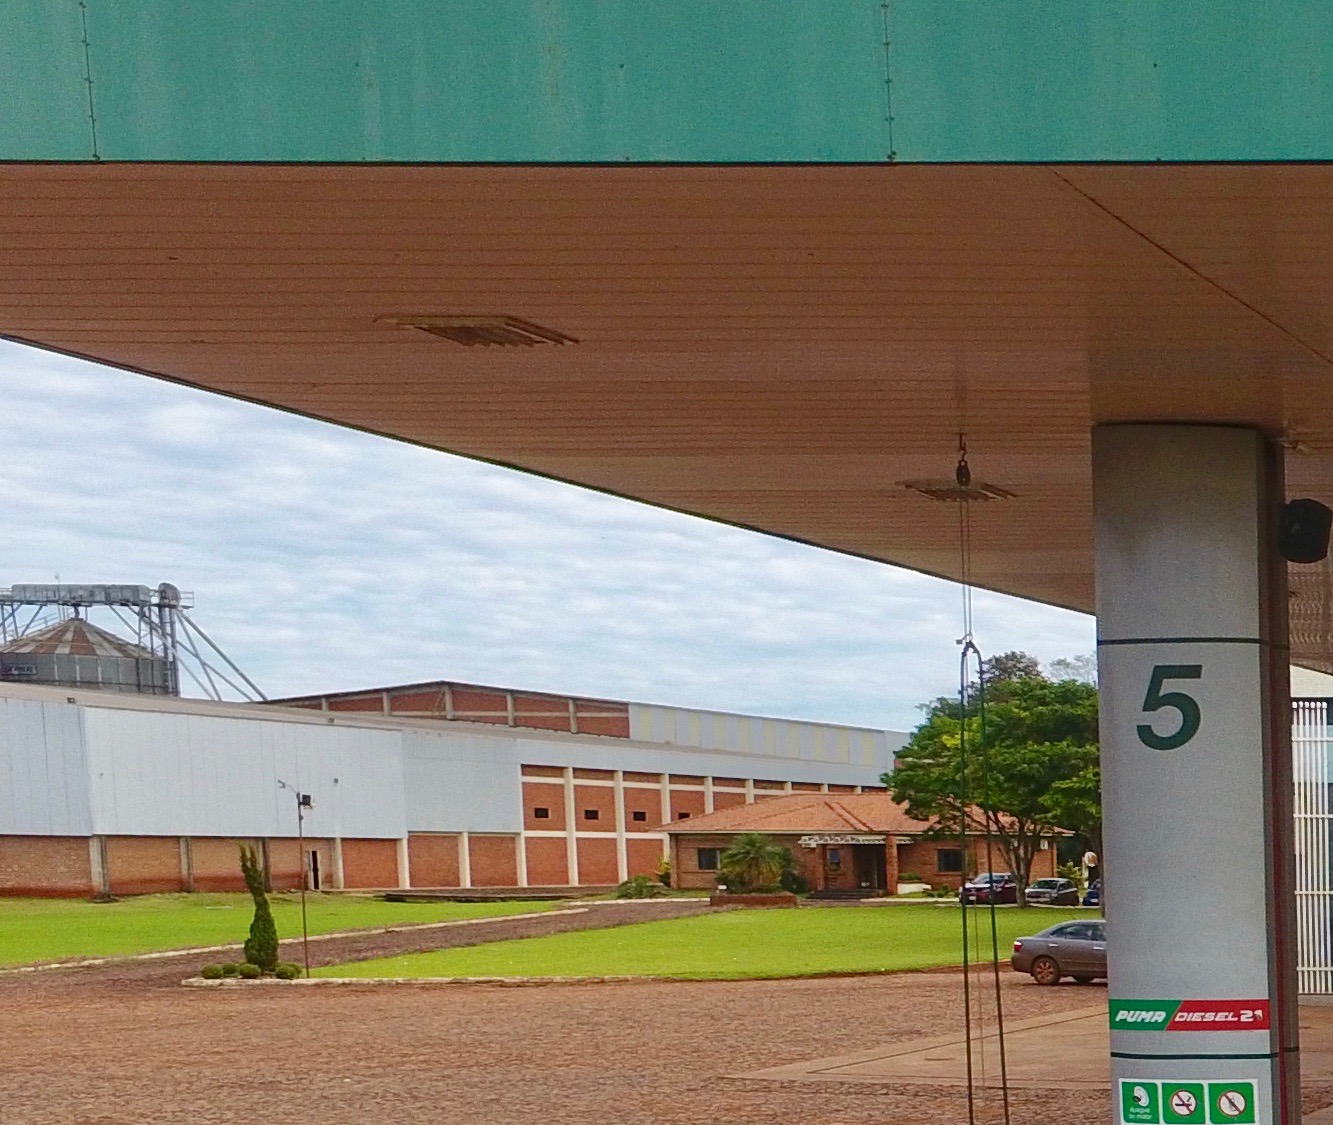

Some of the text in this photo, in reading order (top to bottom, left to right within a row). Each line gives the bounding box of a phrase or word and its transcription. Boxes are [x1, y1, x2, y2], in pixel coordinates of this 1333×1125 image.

[1136, 664, 1203, 751] 5
[1114, 1009, 1167, 1023] PUMA
[1173, 1011, 1239, 1022] DIESEL
